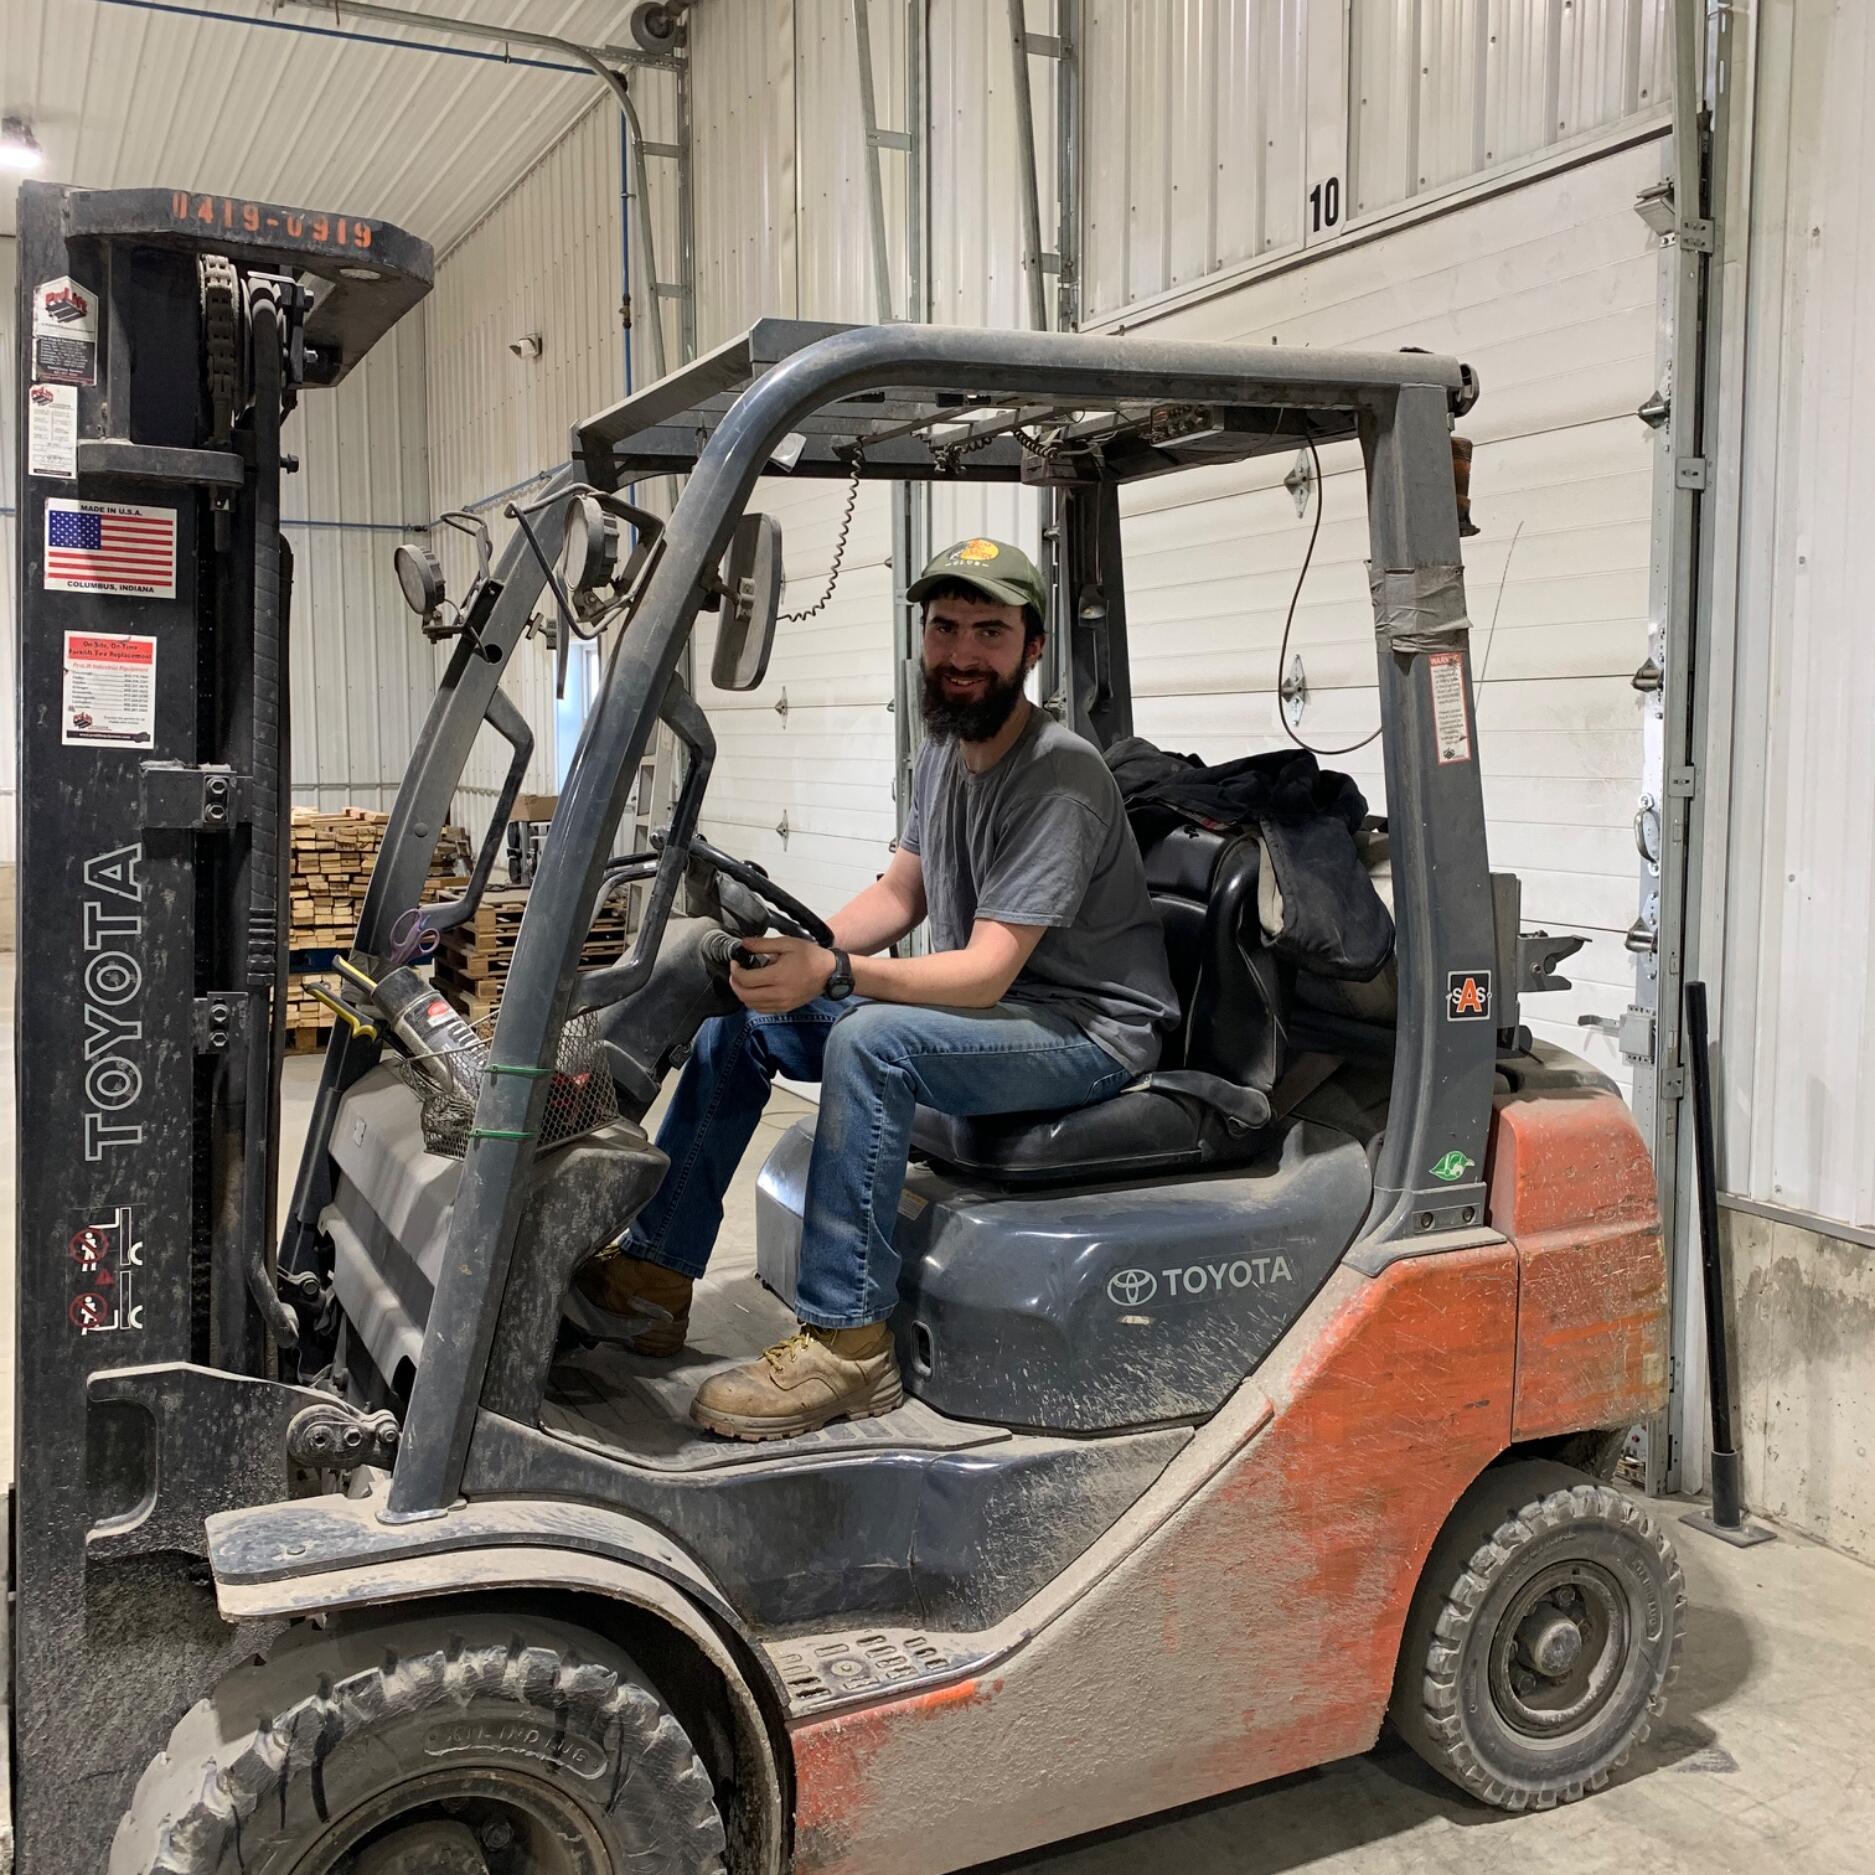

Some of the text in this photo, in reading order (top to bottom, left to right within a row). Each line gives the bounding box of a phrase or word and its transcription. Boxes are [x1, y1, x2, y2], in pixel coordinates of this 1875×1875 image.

[172, 190, 372, 248] 0419-0919
[1309, 176, 1339, 232] 10
[81, 505, 105, 513] MADE
[118, 508, 143, 516] U.S.A.
[67, 581, 155, 593] COLUMBUS, INDIANA
[84, 842, 143, 1162] TOYOTA
[1162, 1255, 1293, 1296] TOYOTA
